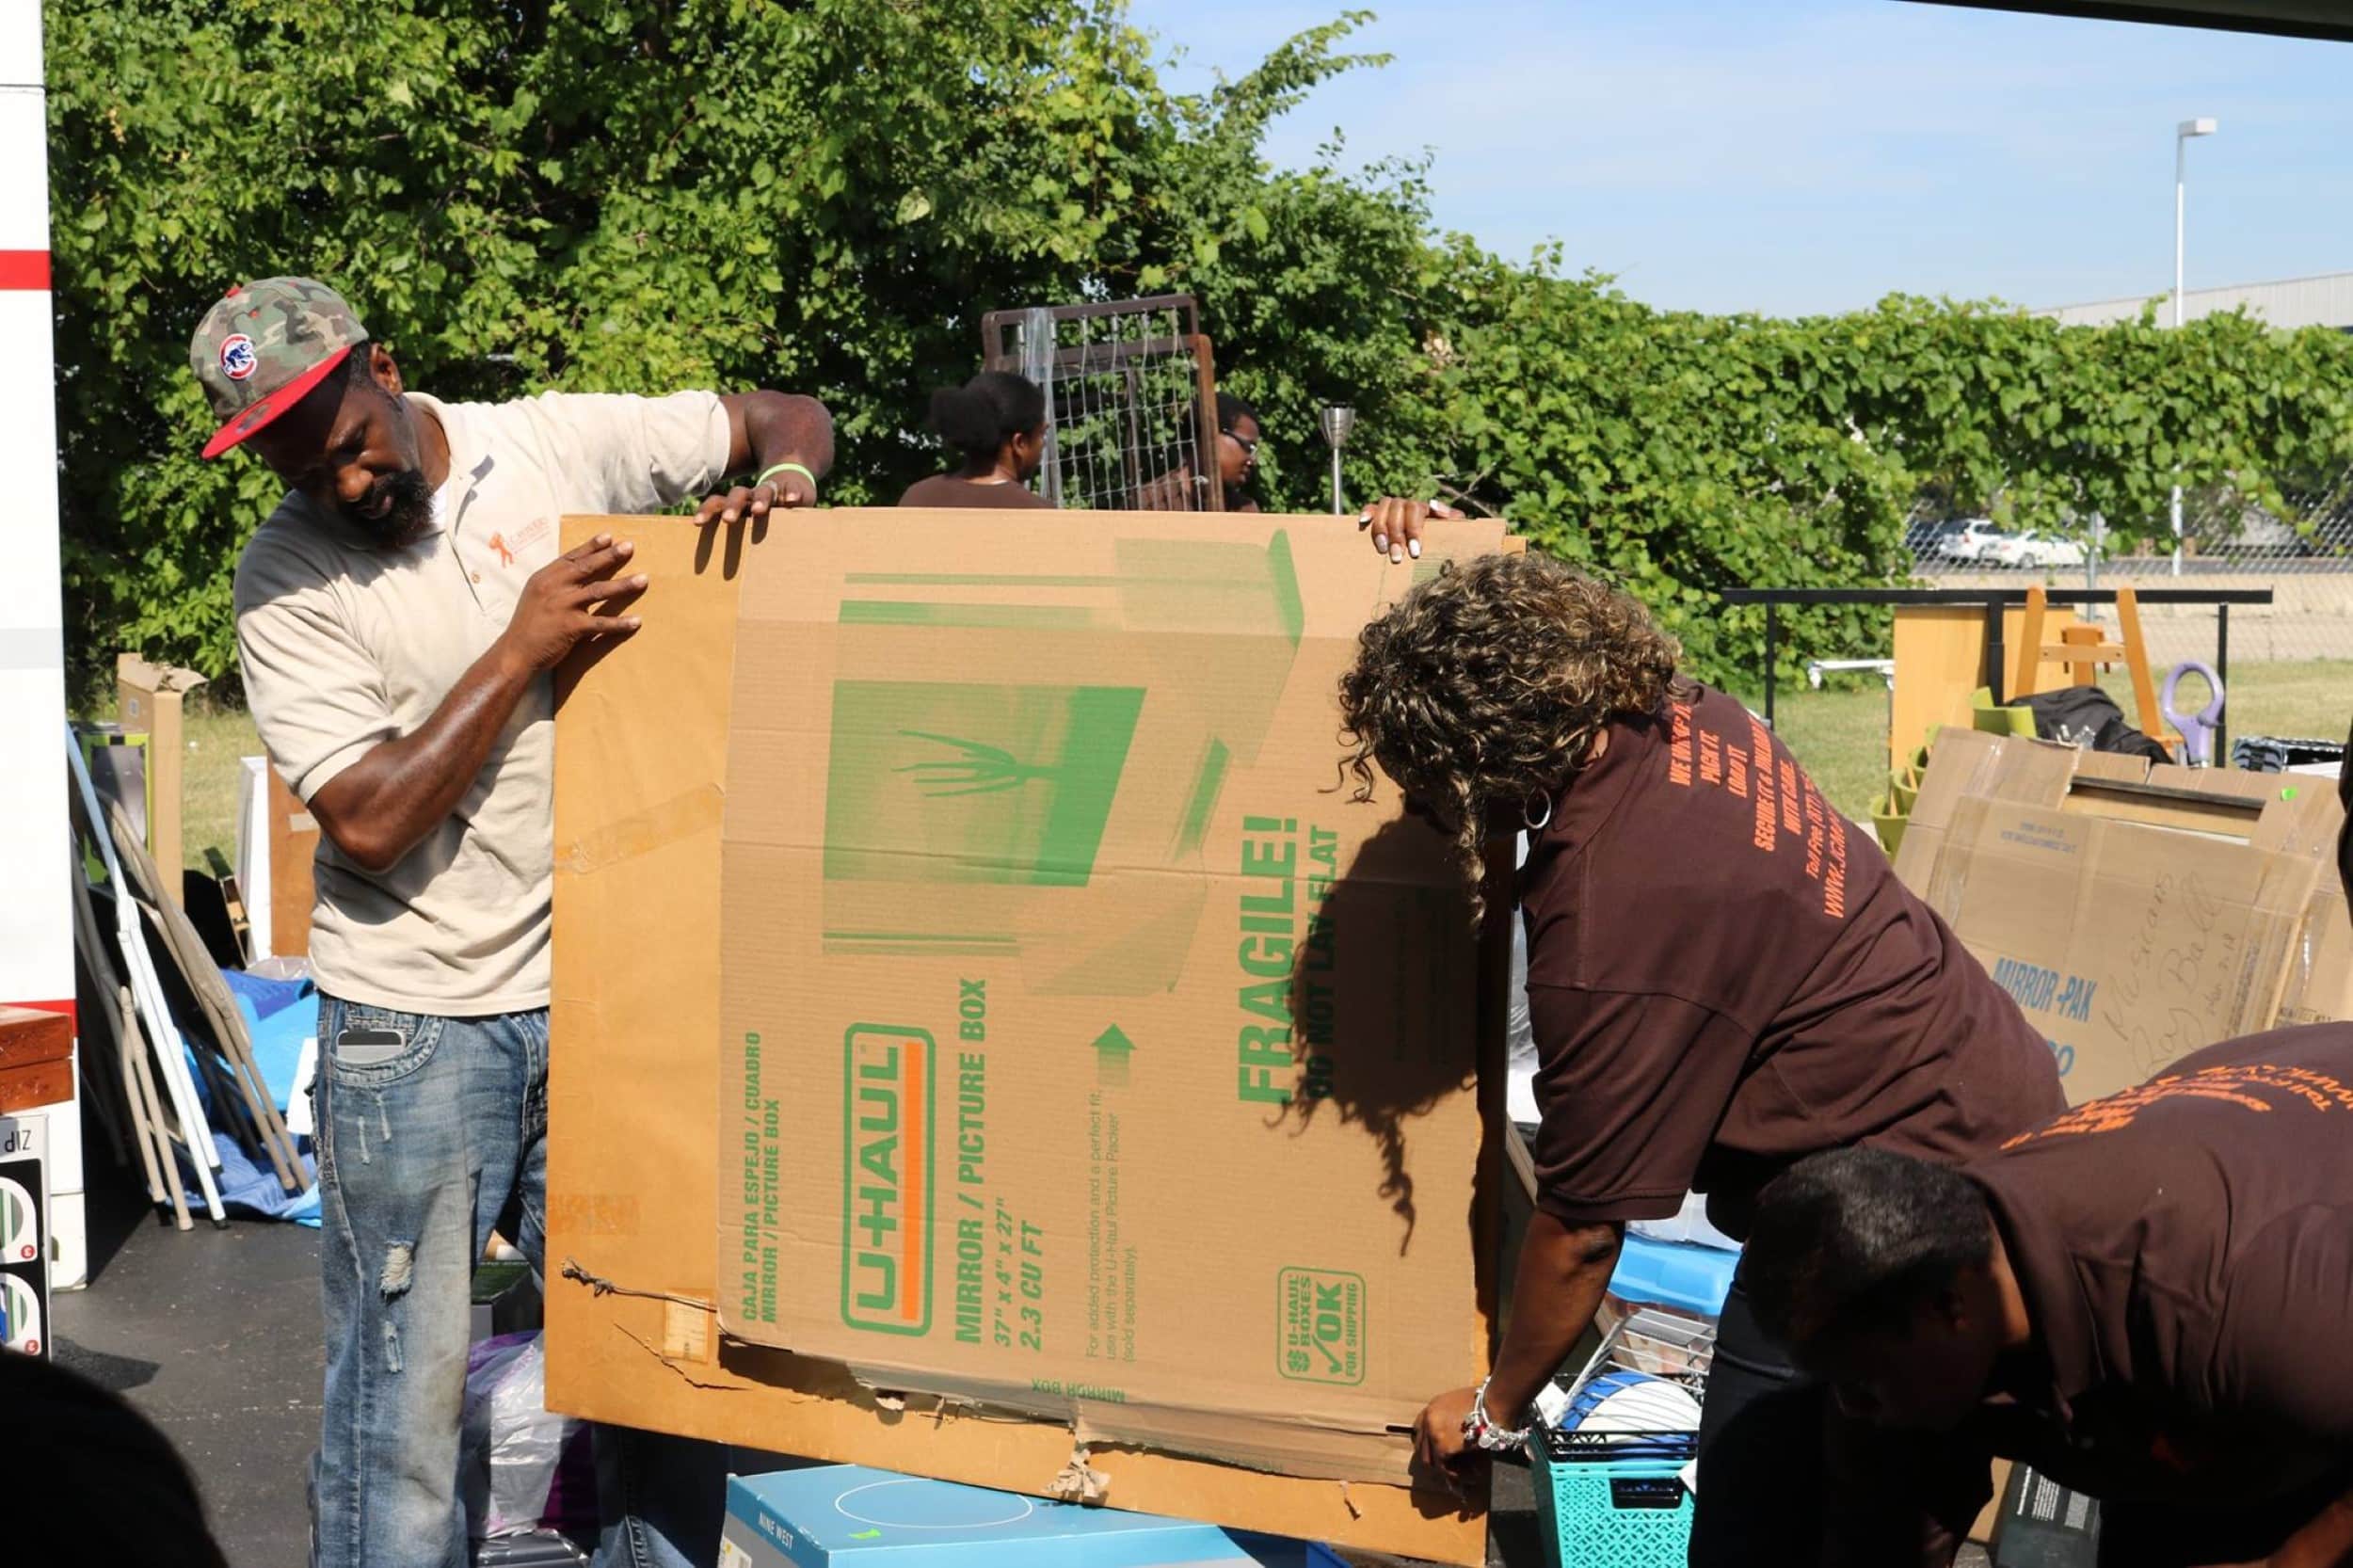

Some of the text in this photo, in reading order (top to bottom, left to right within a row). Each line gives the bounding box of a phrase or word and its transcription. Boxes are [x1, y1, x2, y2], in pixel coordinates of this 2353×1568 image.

[1669, 760, 1691, 786] WE
[1700, 743, 1721, 784] PACK
[1728, 758, 1748, 798] LOAD
[1754, 797, 1776, 852] SECURE
[1782, 794, 1801, 836] WITH
[1808, 824, 1824, 856] Free
[1308, 824, 1338, 904] FLAT
[1805, 852, 1822, 879] Toll
[1238, 814, 1298, 1105] FRAGILE!
[1306, 983, 1335, 1045] NOT
[744, 1031, 761, 1112] CUADRO
[762, 1098, 781, 1140] BOX
[1090, 1111, 1104, 1161] perfect
[744, 1130, 760, 1206] ESPEJO
[761, 1145, 780, 1227] PICTURE
[954, 978, 988, 1345] MIRROR / PICTURE BOX
[1090, 1178, 1100, 1206] and
[743, 1211, 760, 1265] PARA
[1088, 1210, 1103, 1282] protection
[1105, 1113, 1120, 1360] use with the U-Haul Picture Packer
[741, 1271, 759, 1321] CAJA
[761, 1246, 779, 1323] MIRROR
[1018, 1220, 1045, 1352] 2.3 CU FT
[1088, 1286, 1100, 1331] added
[1300, 1275, 1311, 1346] BOXES
[1316, 1281, 1342, 1342] OK
[1086, 1335, 1100, 1358] For
[1123, 1328, 1137, 1366] (sold
[1346, 1282, 1357, 1377] FOR SHIPPING
[1032, 1377, 1126, 1404] MIRROR BOX
[759, 1510, 794, 1551] NINE WEST
